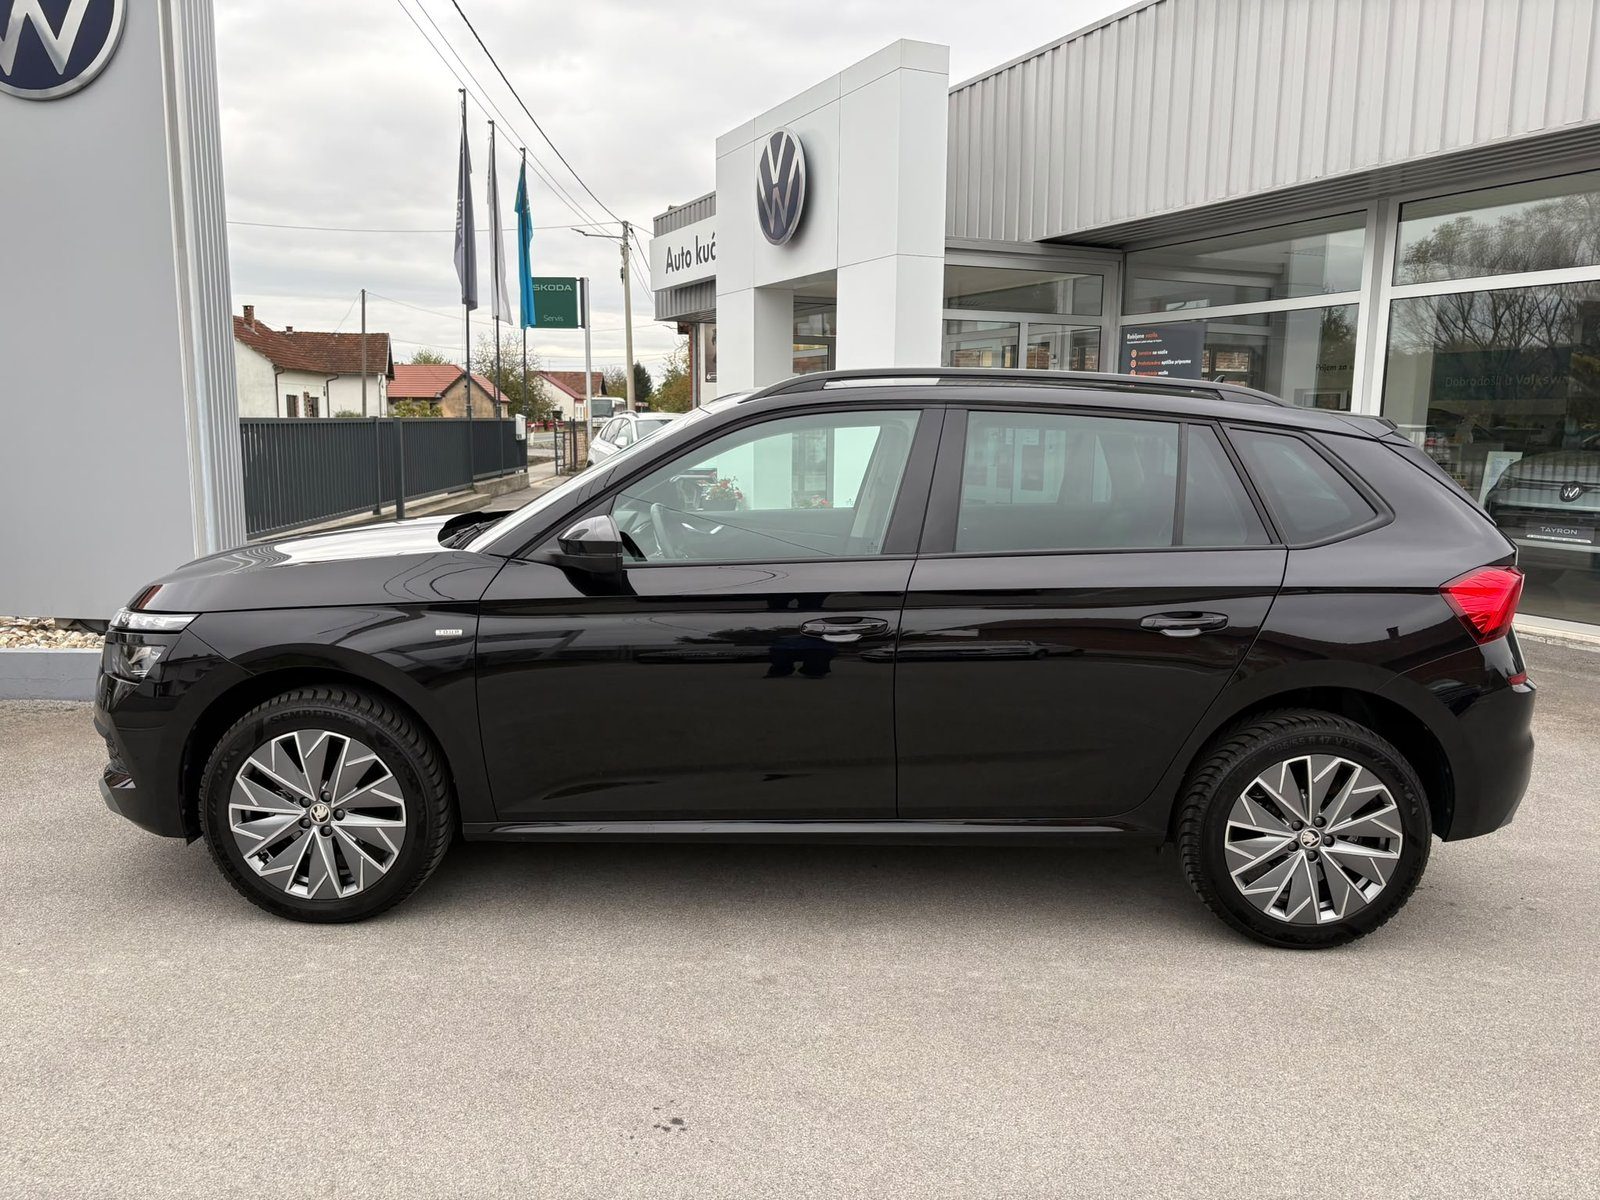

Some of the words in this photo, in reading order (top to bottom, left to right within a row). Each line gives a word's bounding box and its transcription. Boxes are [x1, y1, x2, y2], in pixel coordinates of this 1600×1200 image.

[666, 246, 692, 274] Auto
[696, 232, 716, 266] kuć
[543, 314, 565, 322] Servis
[1540, 526, 1578, 535] TAYRON
